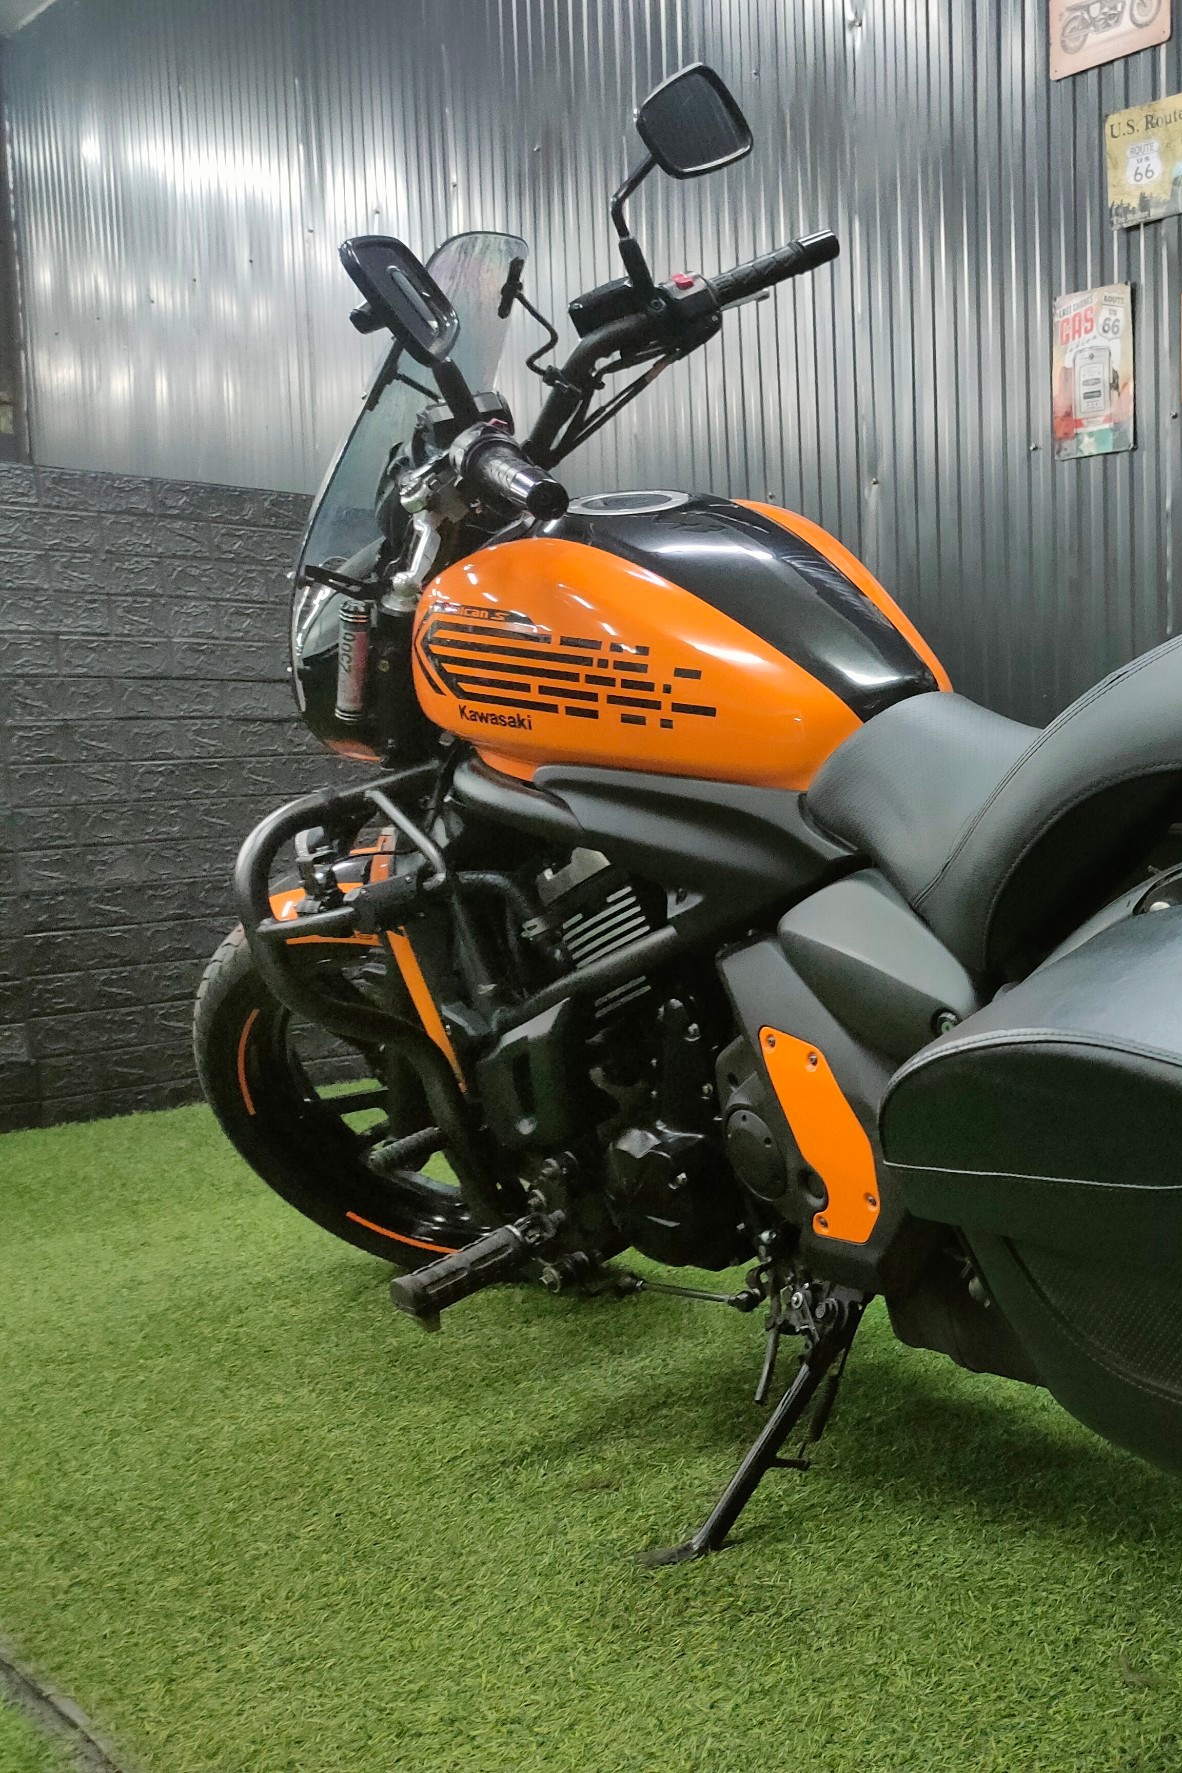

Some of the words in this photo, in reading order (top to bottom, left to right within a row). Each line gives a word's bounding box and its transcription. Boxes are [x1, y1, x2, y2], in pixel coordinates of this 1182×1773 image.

[1110, 119, 1139, 139] U.S.
[1129, 142, 1155, 155] ROUTE
[1133, 164, 1155, 182] 66
[1103, 295, 1125, 305] ROUTE
[1060, 305, 1095, 346] GAS
[1102, 317, 1121, 335] 66
[490, 611, 510, 621] S
[458, 704, 532, 731] Kawasaki
